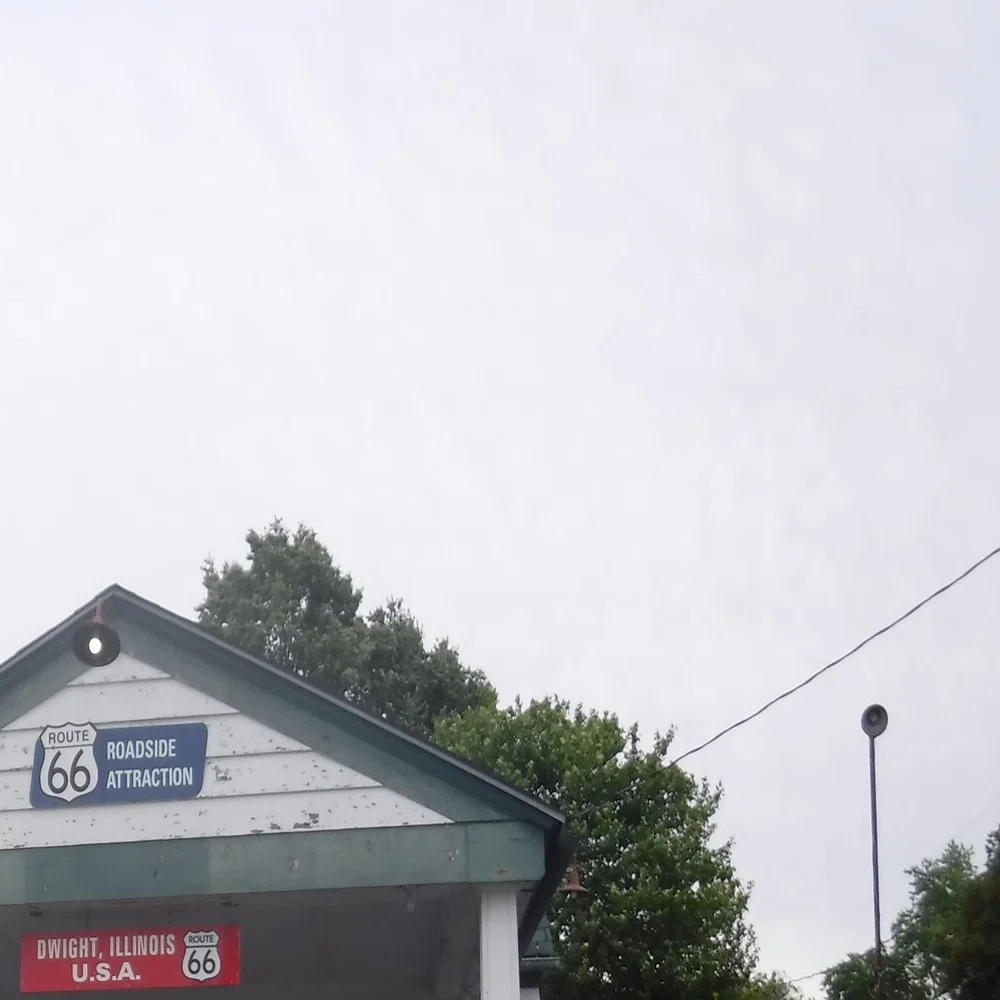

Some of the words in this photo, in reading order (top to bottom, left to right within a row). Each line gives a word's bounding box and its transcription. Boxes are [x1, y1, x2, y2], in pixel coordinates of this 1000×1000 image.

[48, 729, 89, 744] ROUTE
[106, 738, 176, 760] ROADSIDE
[47, 748, 91, 794] 66
[106, 766, 193, 789] ATTRACTION
[36, 936, 103, 960] DWIGHT,
[109, 933, 175, 957] ILLINOIS
[188, 934, 214, 944] ROUTE
[71, 961, 141, 982] U.S.A.
[187, 949, 216, 975] 66
